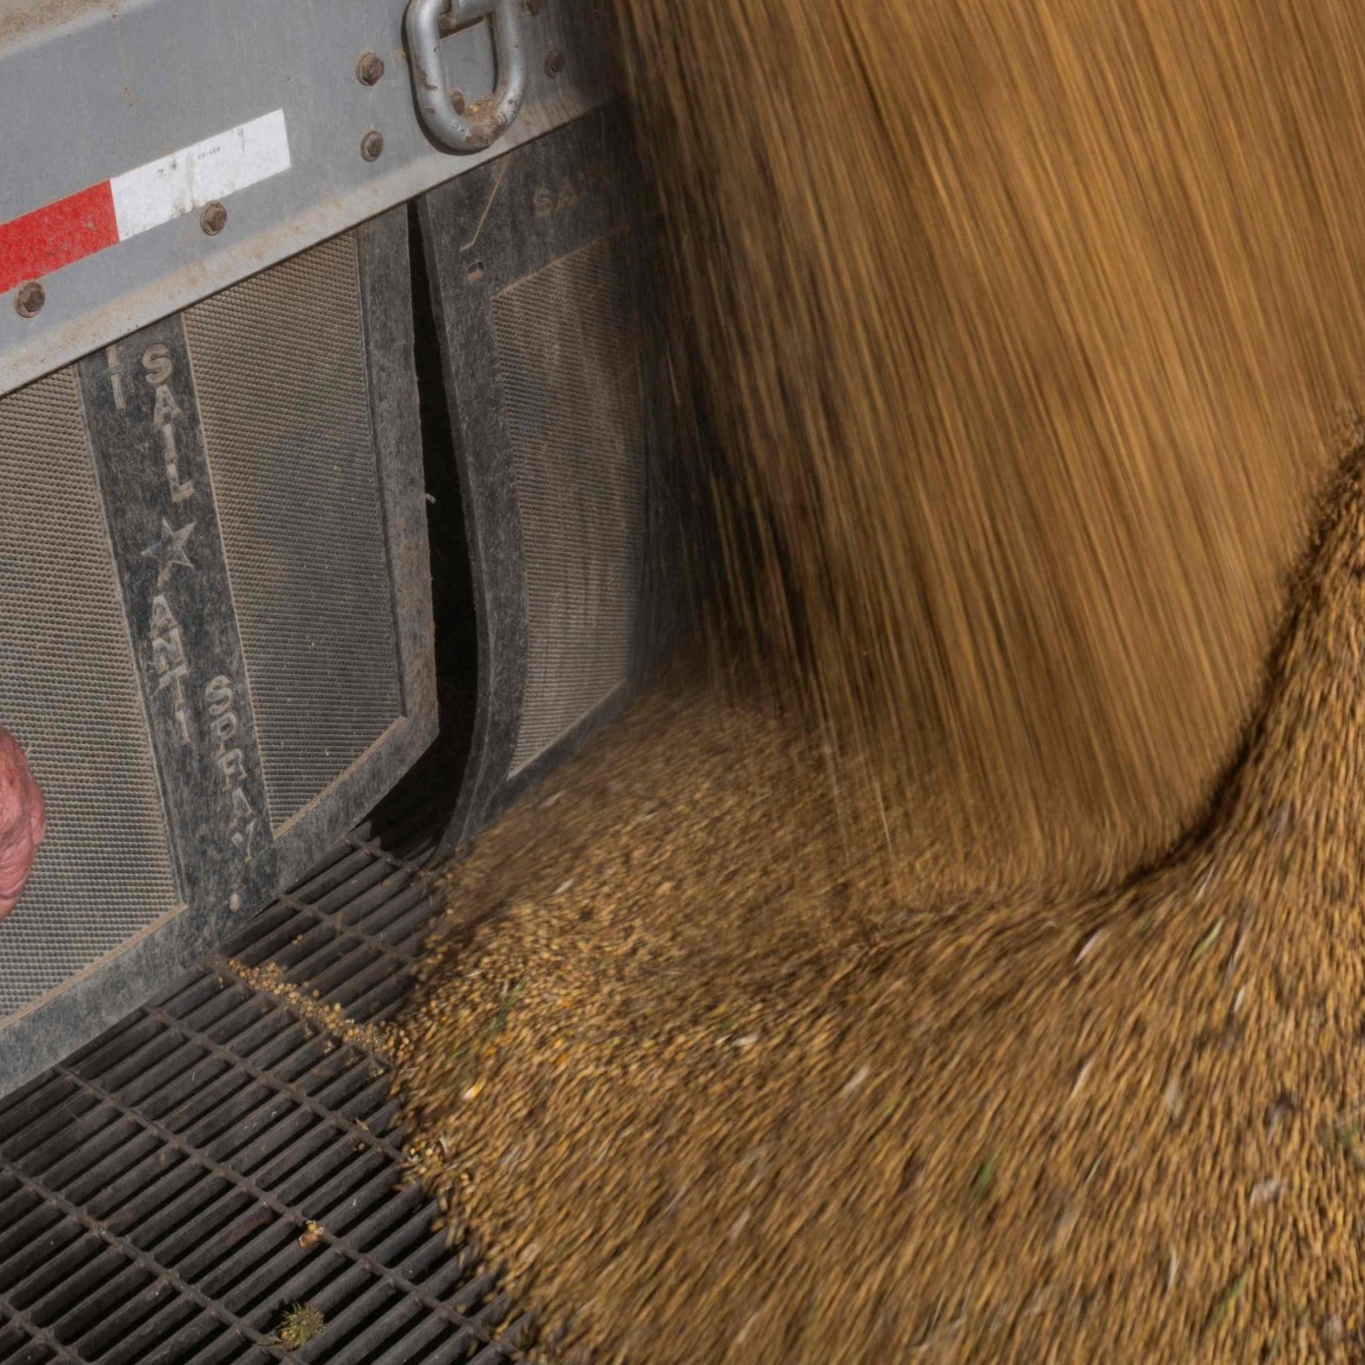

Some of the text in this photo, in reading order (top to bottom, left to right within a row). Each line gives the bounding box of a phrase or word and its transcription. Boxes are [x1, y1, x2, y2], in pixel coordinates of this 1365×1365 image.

[142, 342, 194, 502] SAIL
[150, 594, 191, 744] ANTI
[204, 673, 254, 863] SPRAY
